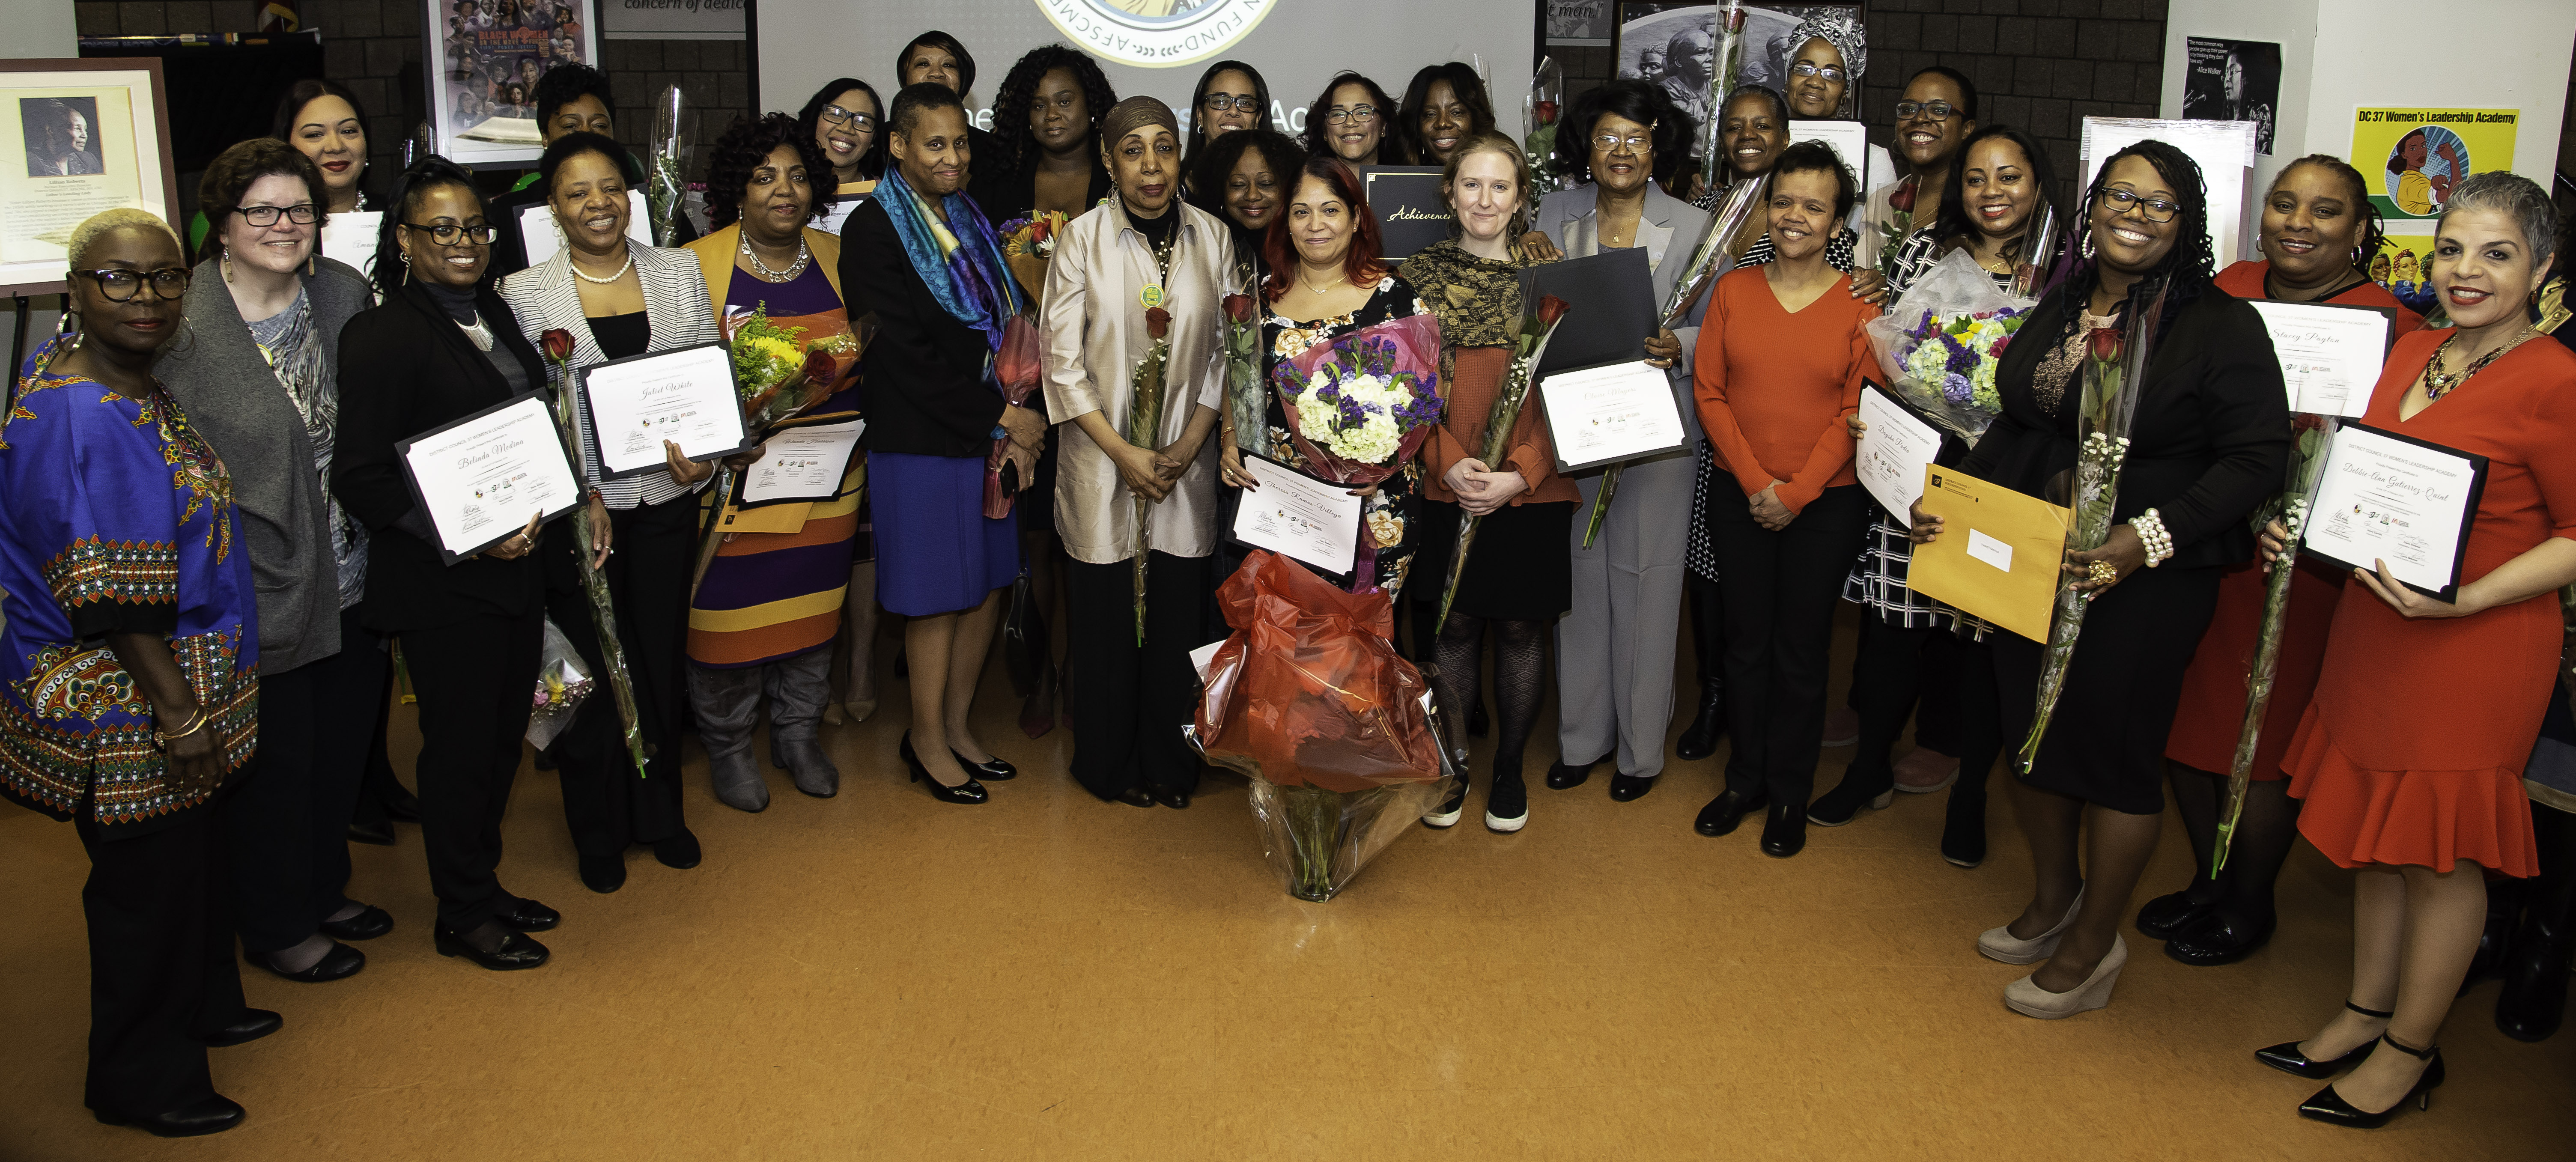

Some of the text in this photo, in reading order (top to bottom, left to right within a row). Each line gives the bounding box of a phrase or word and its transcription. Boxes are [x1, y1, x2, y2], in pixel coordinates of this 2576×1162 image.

[625, 0, 682, 9] concern
[686, 0, 698, 13] of
[479, 31, 508, 39] BLACK
[1050, 0, 1129, 50] AFSCME
[1185, 12, 1242, 50] FUND
[2358, 111, 2516, 124] DC 37 Women's Leadership Academy
[1387, 205, 1451, 221] Achieveme
[2268, 329, 2339, 344] Stacey Payton
[638, 381, 692, 400] Juliet White
[1870, 400, 1879, 409] DISTRICT
[1879, 408, 1888, 417] COUNCIL
[1892, 417, 1902, 427] WOMEN'S
[1902, 425, 1918, 436] LEADERSHIP
[1917, 435, 1930, 445] ACADEMY
[429, 446, 447, 456] DISTRICT
[449, 440, 467, 448] COUNCIL
[472, 429, 492, 439] WOMEN'S
[492, 420, 516, 432] LEADERSHIP
[517, 413, 534, 422] ACADEMY
[458, 451, 489, 469] Belinda
[492, 440, 523, 454] Medina
[2365, 448, 2382, 456] COUNCIL
[2388, 456, 2408, 464] WOMEN'S
[2408, 461, 2435, 471] LEADERSHIP
[2435, 469, 2457, 477] ACADEMY
[2343, 462, 2385, 482] Debbie-Ann
[1264, 480, 1288, 495] Theresa
[1274, 473, 1289, 481] COUNCIL
[1294, 481, 1309, 489] WOMEN'S
[1309, 488, 1330, 498] LEADERSHIP
